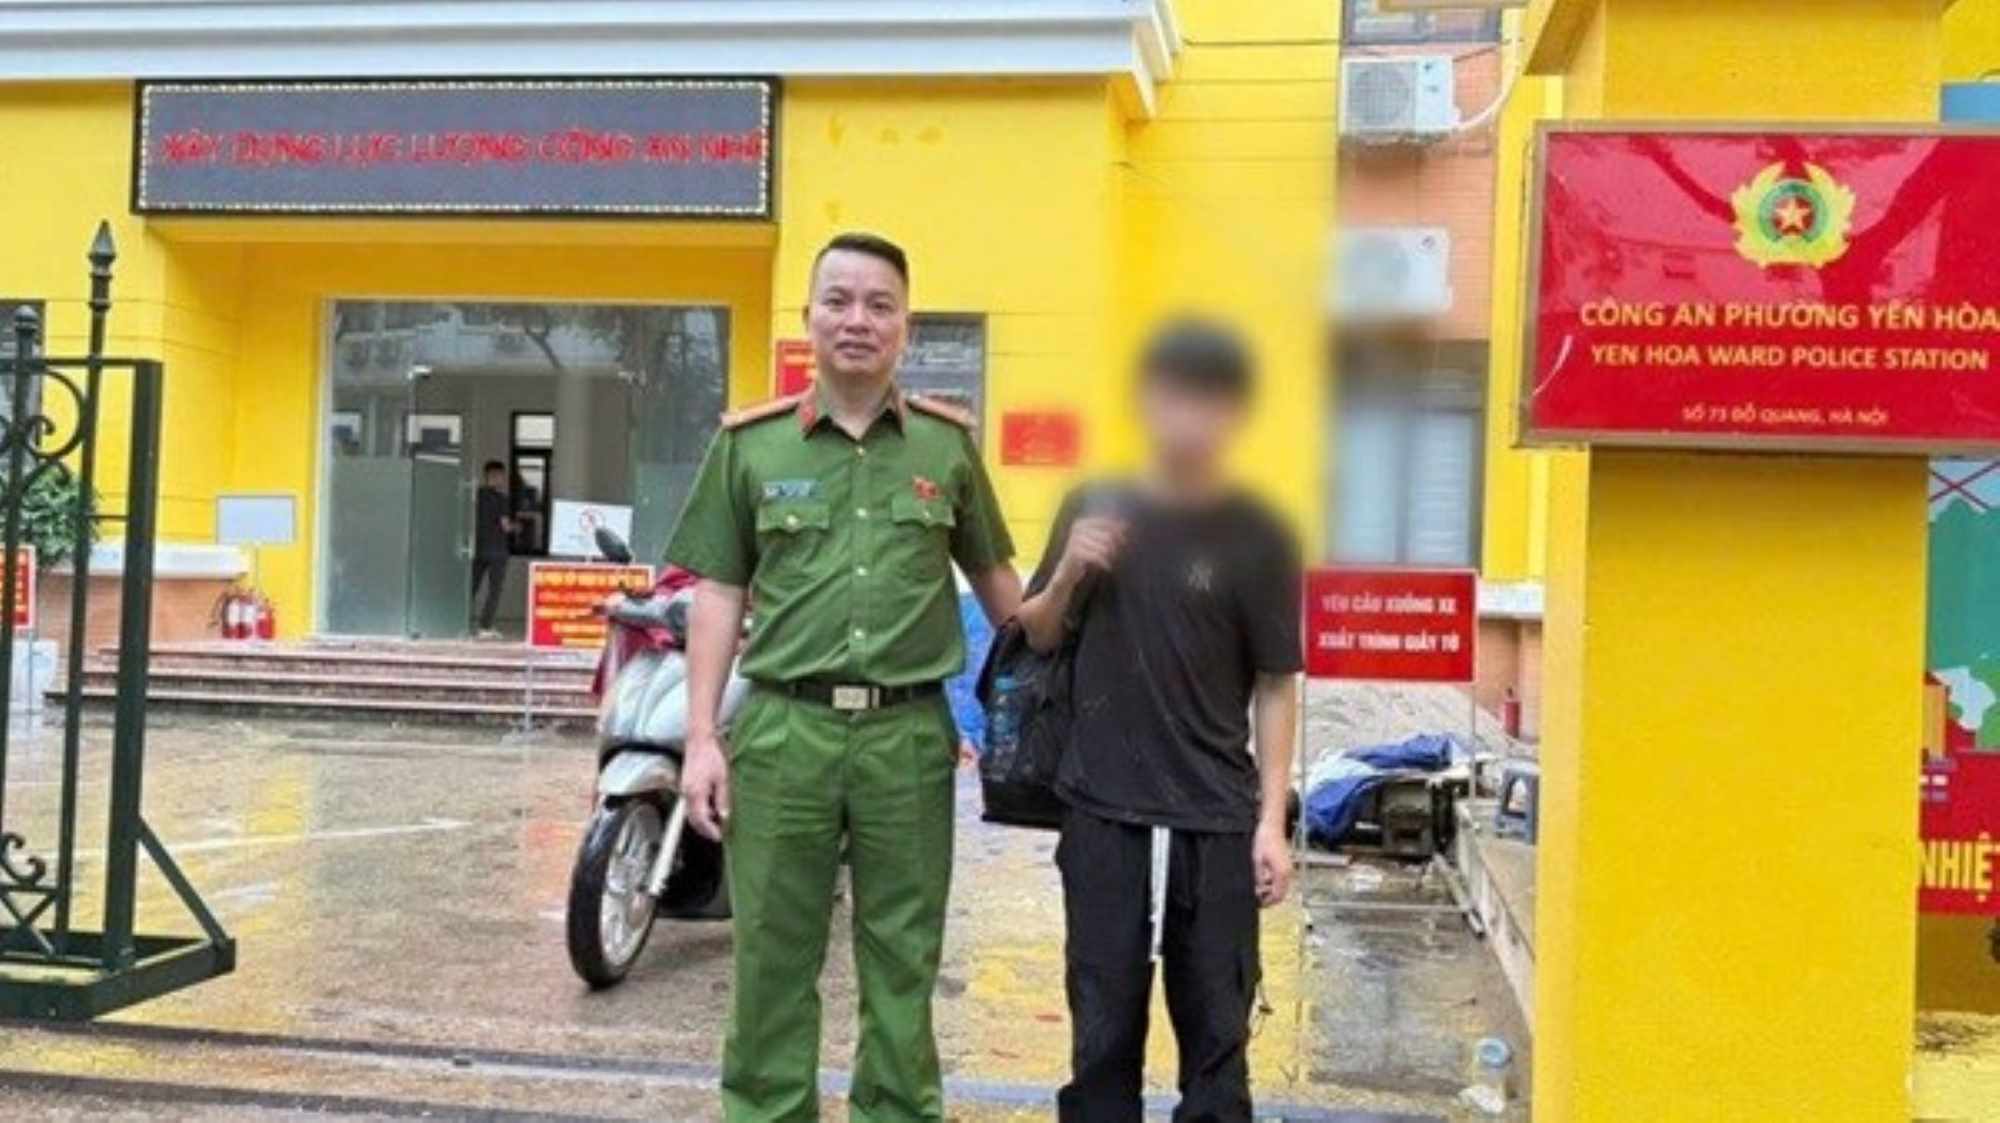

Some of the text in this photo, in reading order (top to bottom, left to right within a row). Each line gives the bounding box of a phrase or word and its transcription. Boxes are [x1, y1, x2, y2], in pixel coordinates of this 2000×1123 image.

[538, 126, 634, 163] CÔNG
[1580, 297, 2000, 331] CÔNG AN PHƯỜNG YÊN HÒA
[1592, 345, 1990, 371] YEN HOA WARD POLICE STATION
[1917, 831, 2000, 903] NHIỆ
